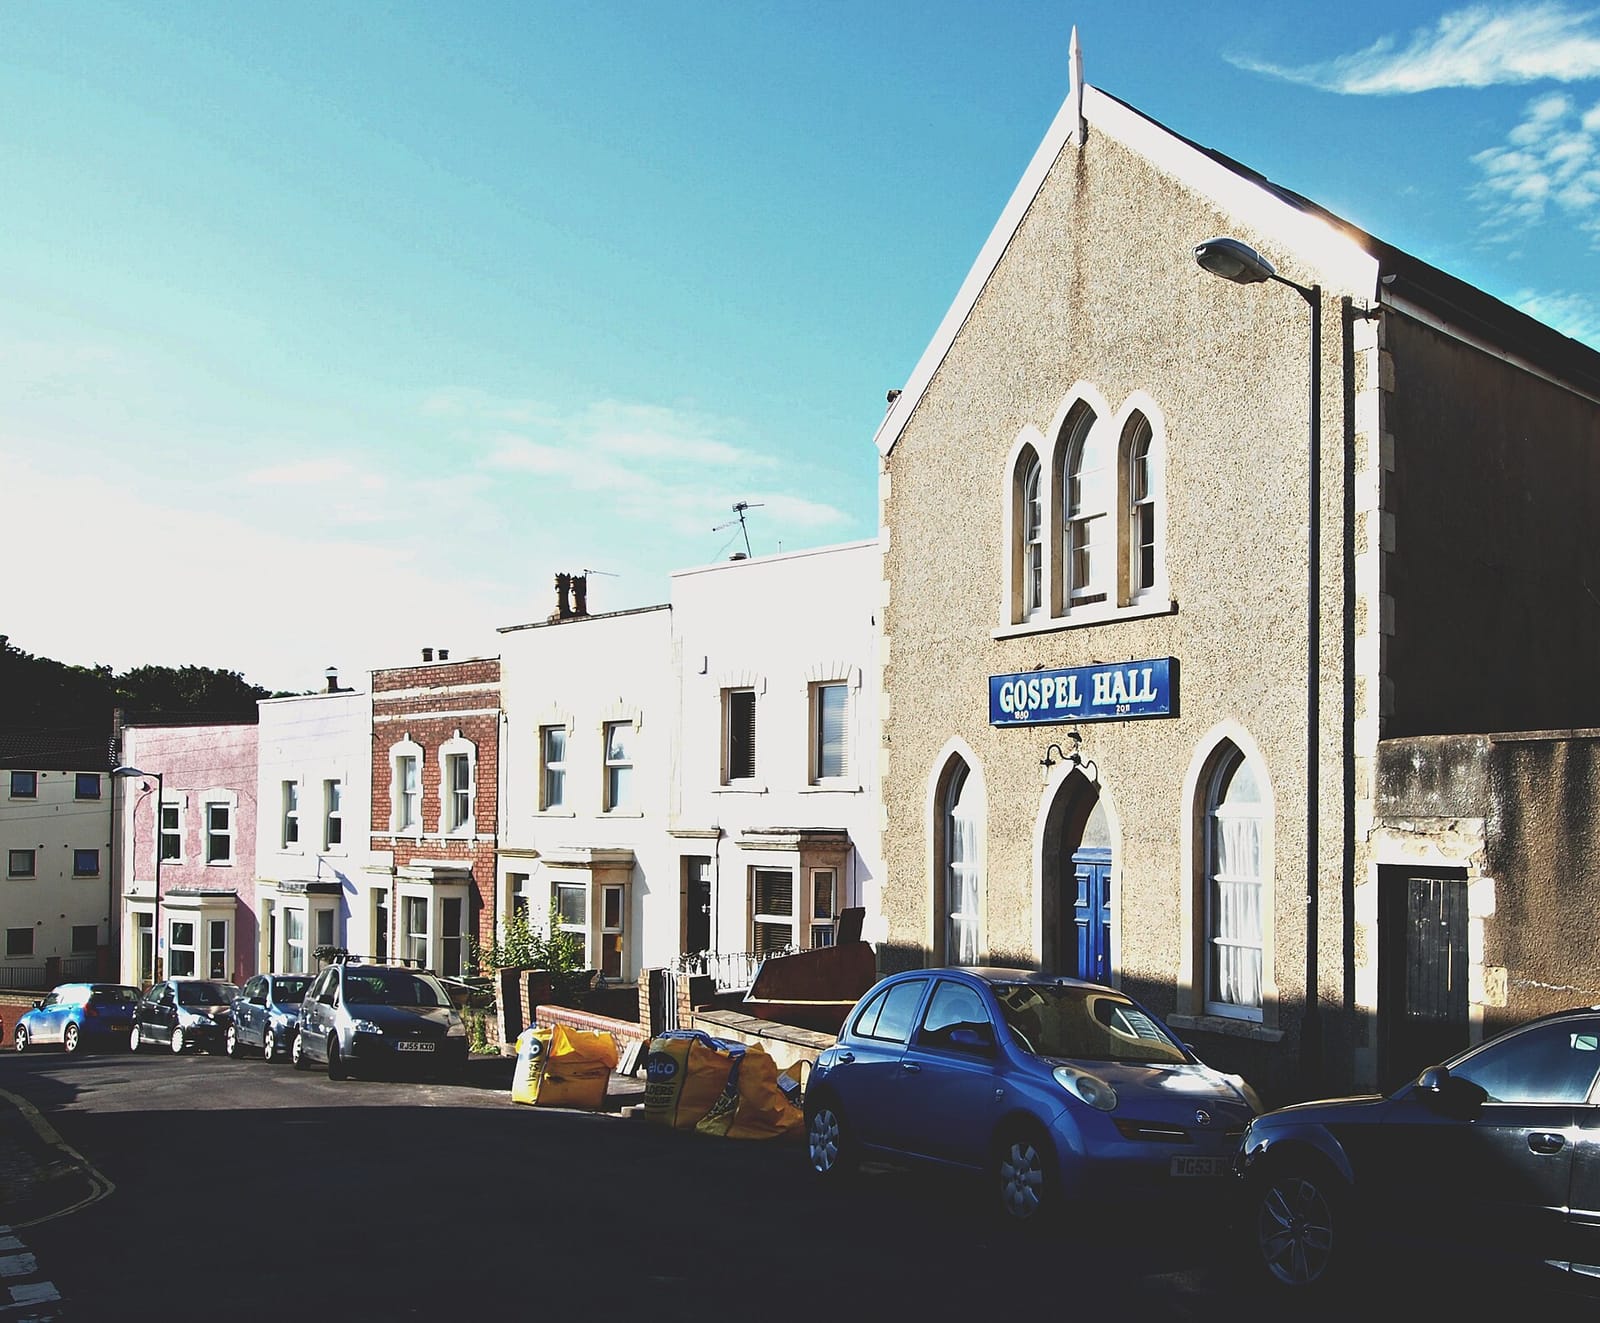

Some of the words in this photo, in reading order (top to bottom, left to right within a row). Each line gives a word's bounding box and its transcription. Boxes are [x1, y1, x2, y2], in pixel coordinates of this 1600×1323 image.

[999, 675, 1082, 713] GOSPEL
[1091, 668, 1158, 706] HALL
[1115, 703, 1131, 712] 2011
